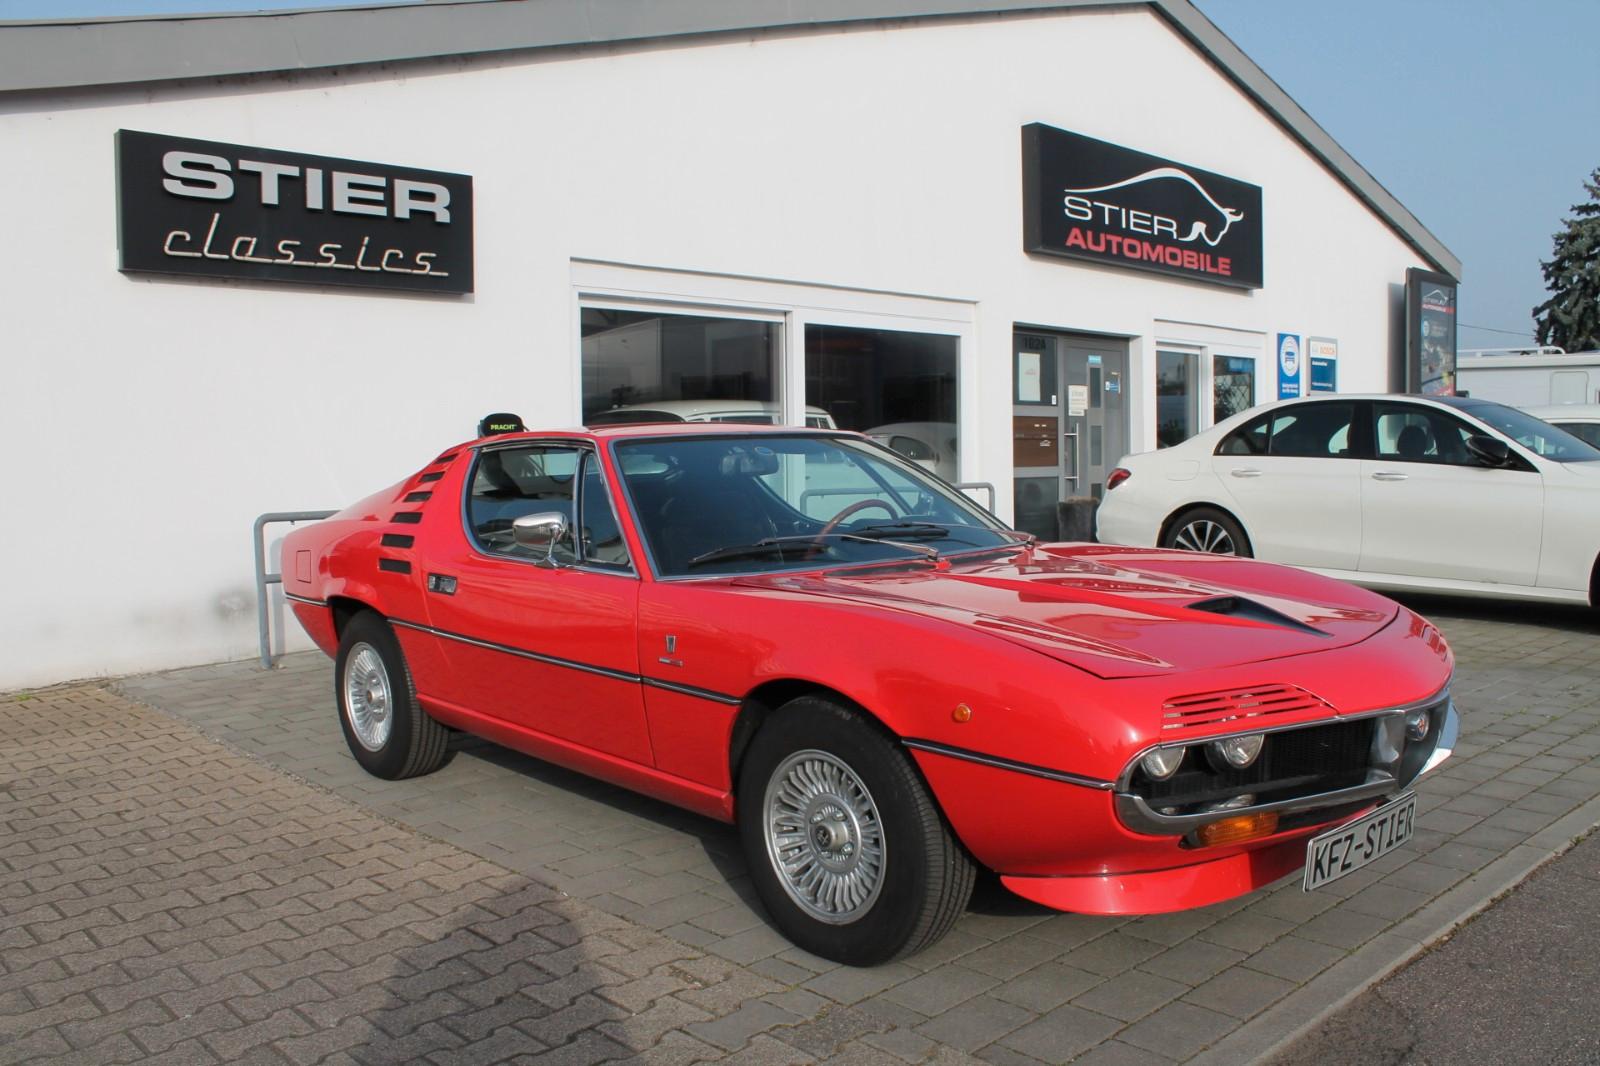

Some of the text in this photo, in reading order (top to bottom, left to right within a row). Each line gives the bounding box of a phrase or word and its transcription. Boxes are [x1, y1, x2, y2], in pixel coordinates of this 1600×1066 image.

[162, 150, 451, 224] STIER
[1064, 195, 1178, 240] STIER
[163, 212, 449, 277] classics
[1065, 226, 1232, 276] AUTOMOBILE
[1313, 802, 1415, 884] KFZ-STIER
